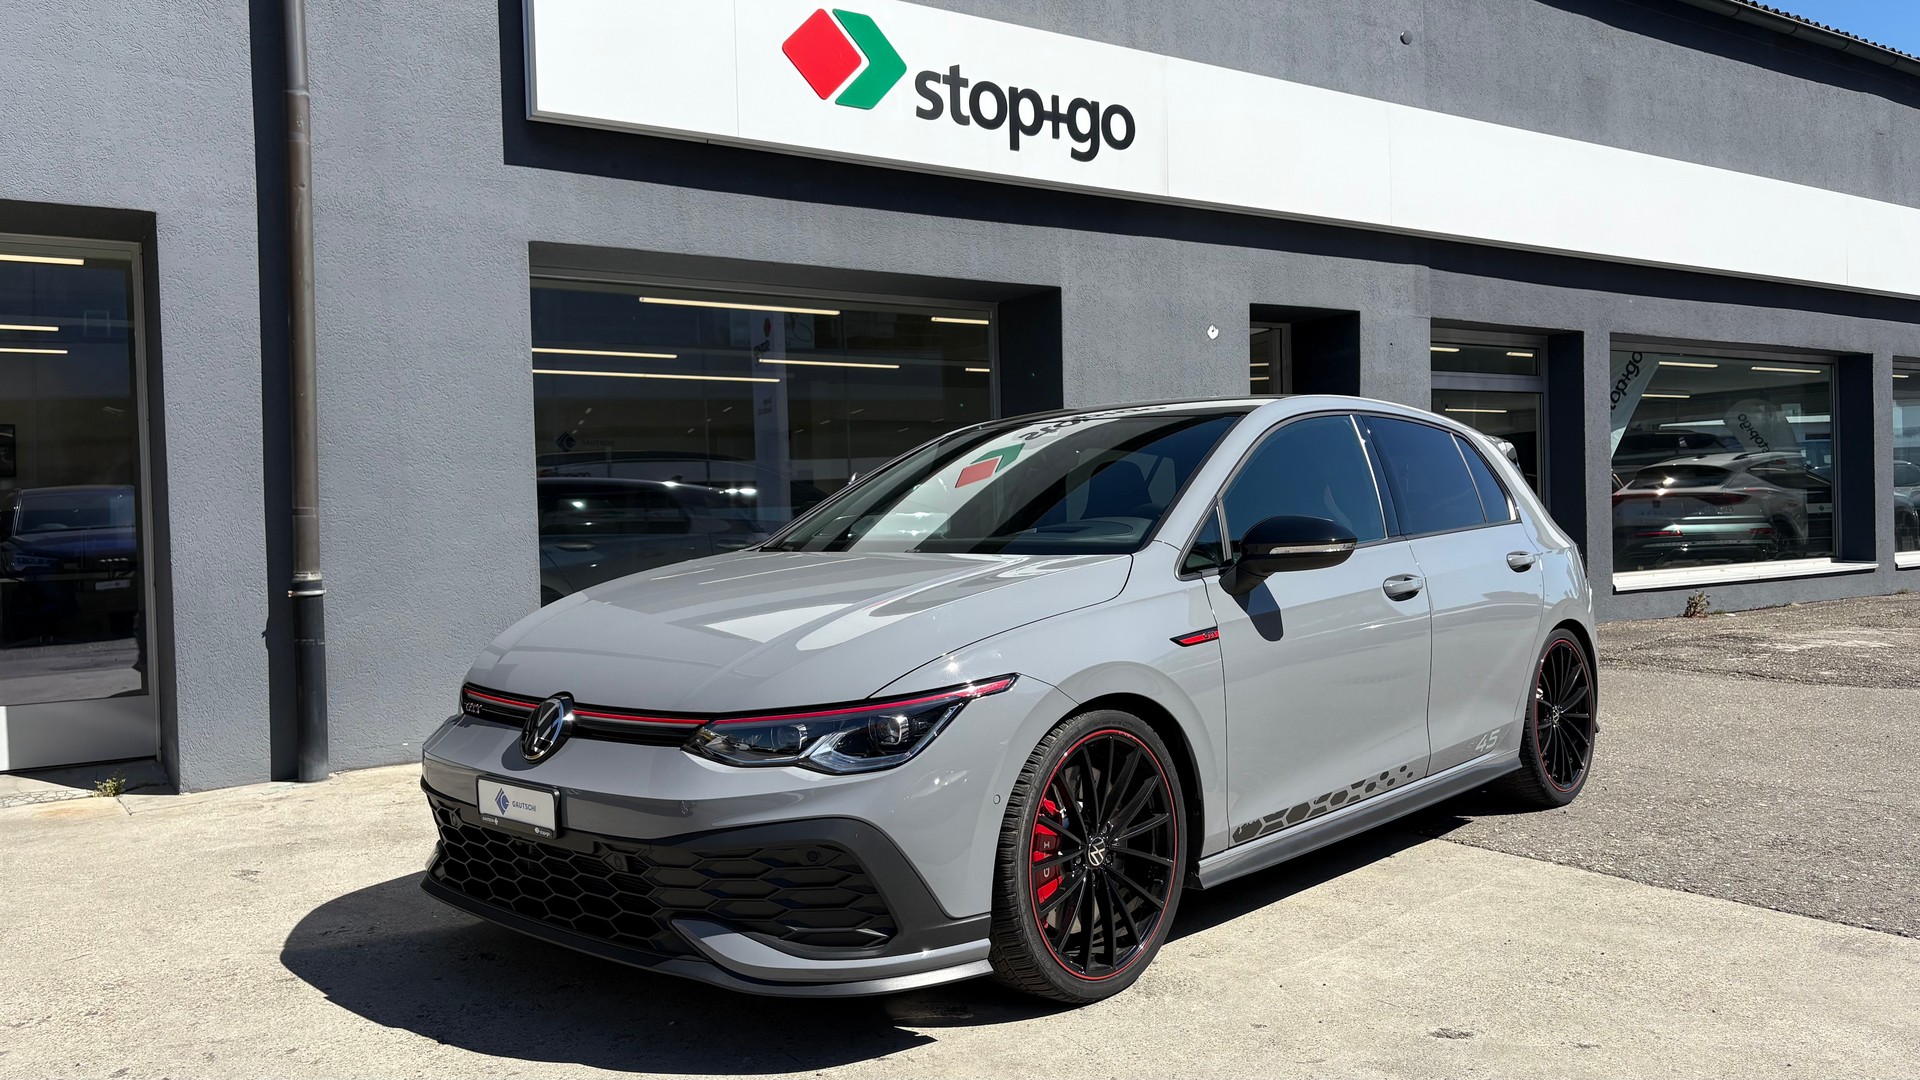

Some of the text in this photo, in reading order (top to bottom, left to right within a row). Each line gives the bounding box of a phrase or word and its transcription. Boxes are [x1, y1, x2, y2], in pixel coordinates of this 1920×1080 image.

[914, 64, 1136, 163] stop+go
[1610, 351, 1643, 412] op+go
[1475, 728, 1501, 752] 45
[511, 800, 537, 812] GAUTSCHI
